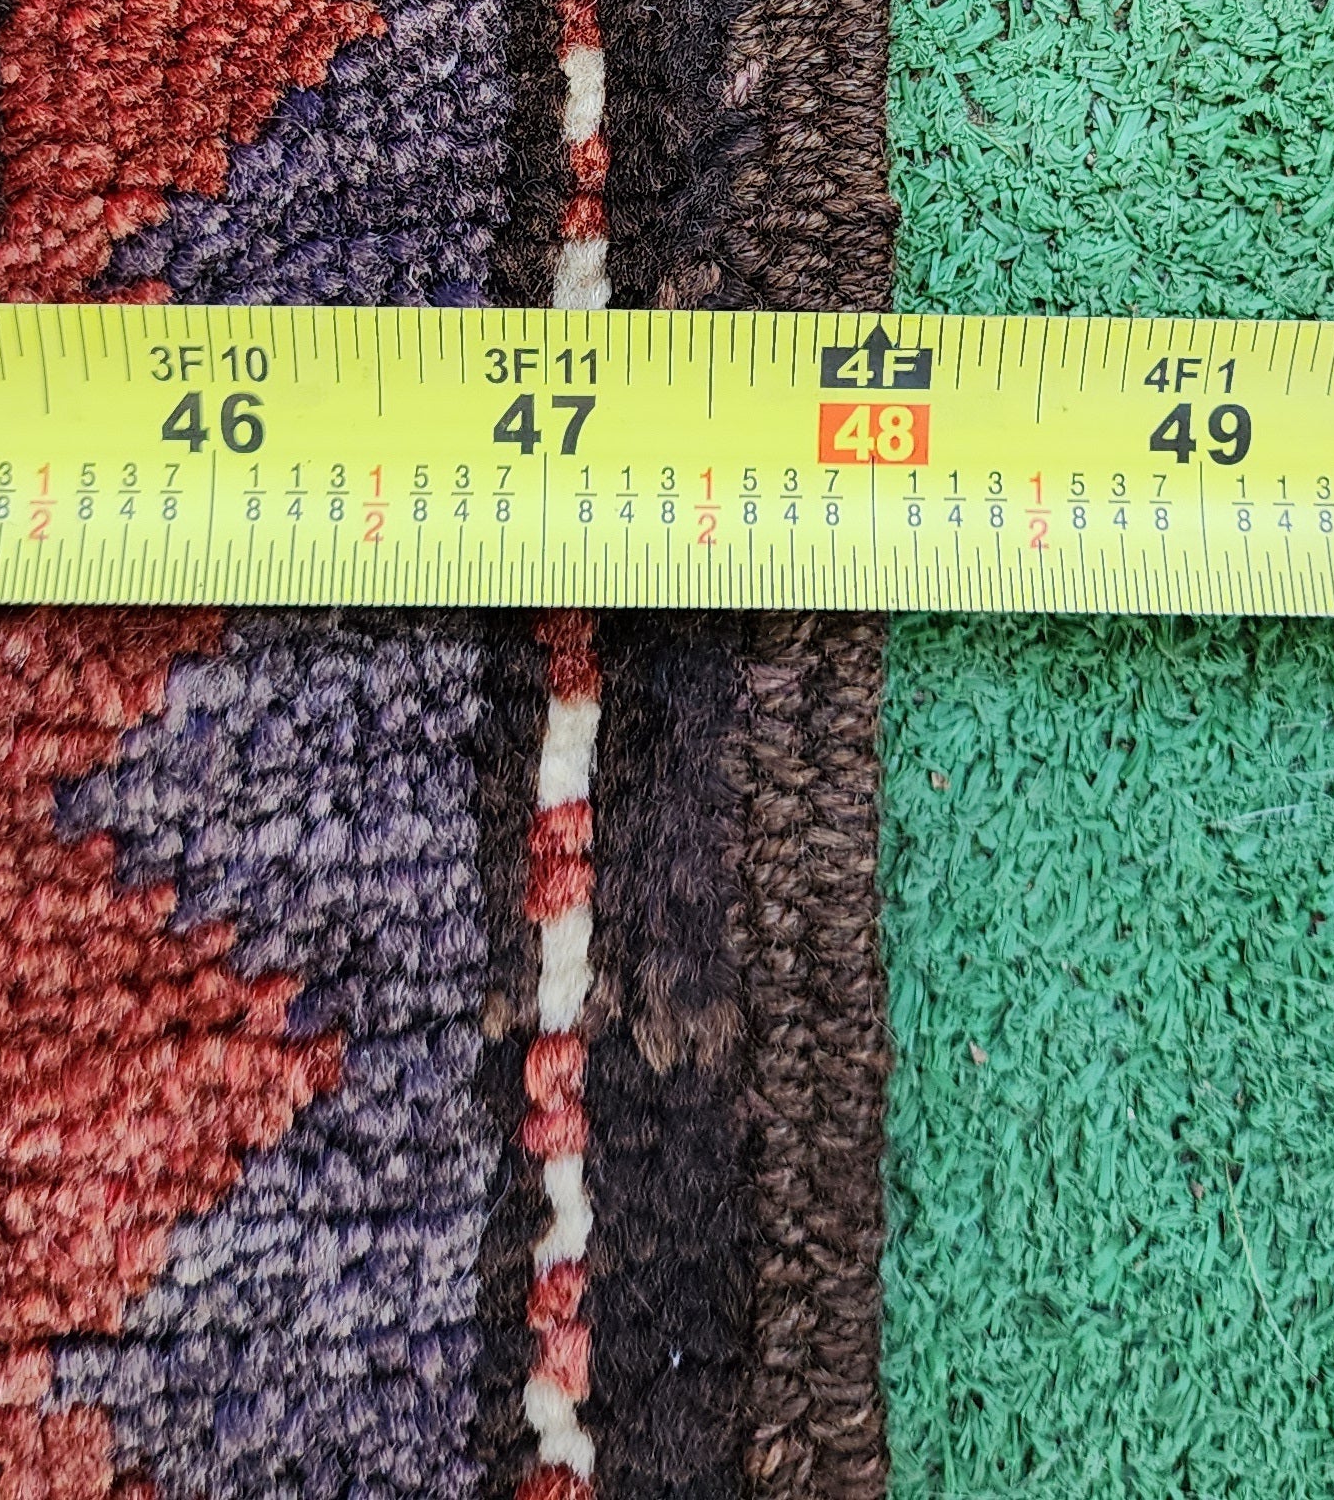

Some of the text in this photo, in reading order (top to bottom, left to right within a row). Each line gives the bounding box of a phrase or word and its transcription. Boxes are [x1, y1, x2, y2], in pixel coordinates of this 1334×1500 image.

[836, 350, 917, 386] 4F
[162, 392, 265, 454] 46
[493, 395, 596, 456] 47
[833, 406, 915, 462] 48
[1149, 403, 1251, 465] 49
